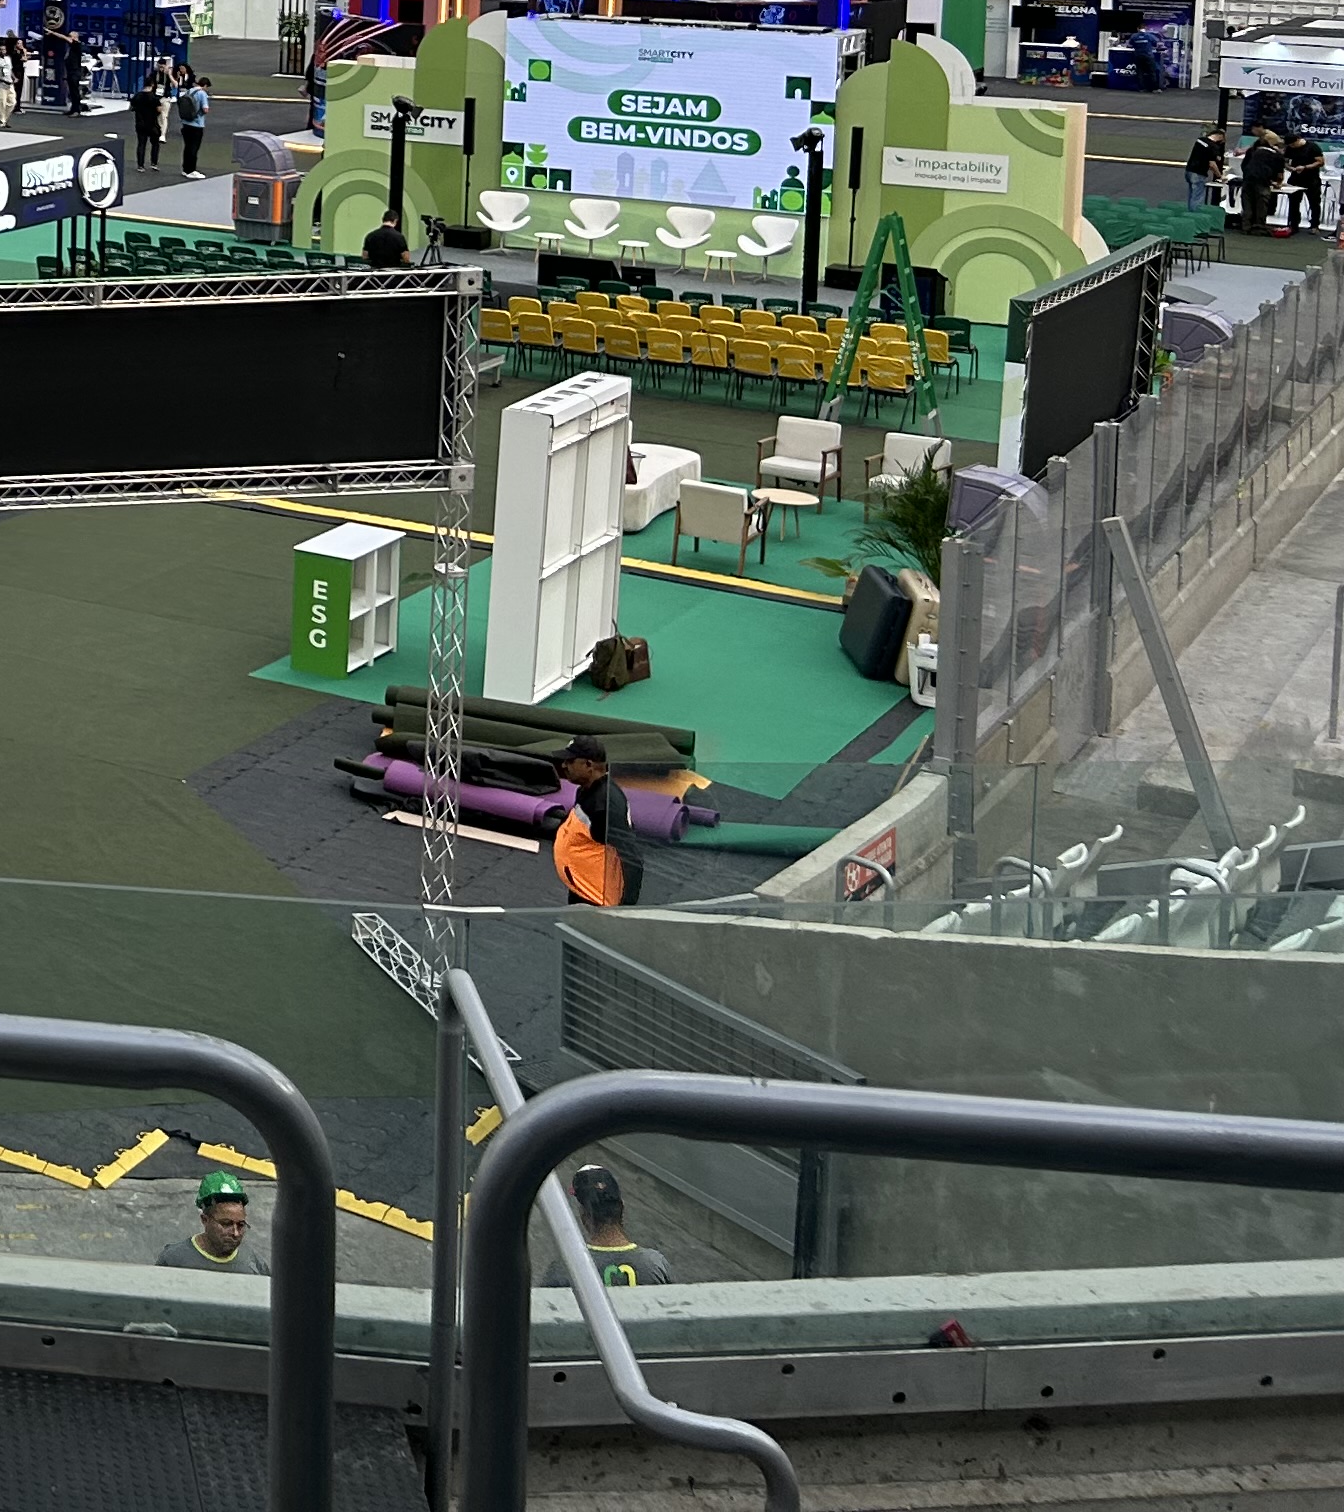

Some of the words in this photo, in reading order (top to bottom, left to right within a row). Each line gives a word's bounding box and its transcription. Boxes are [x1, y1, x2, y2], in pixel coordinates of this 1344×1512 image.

[638, 48, 694, 59] SMARTCITY
[1256, 73, 1306, 87] Taiwan
[620, 95, 707, 118] SEJAM
[371, 111, 457, 129] SMCITY
[580, 120, 749, 151] BEM-VINDOS
[914, 157, 1002, 176] Impactability
[309, 579, 329, 650] ESG
